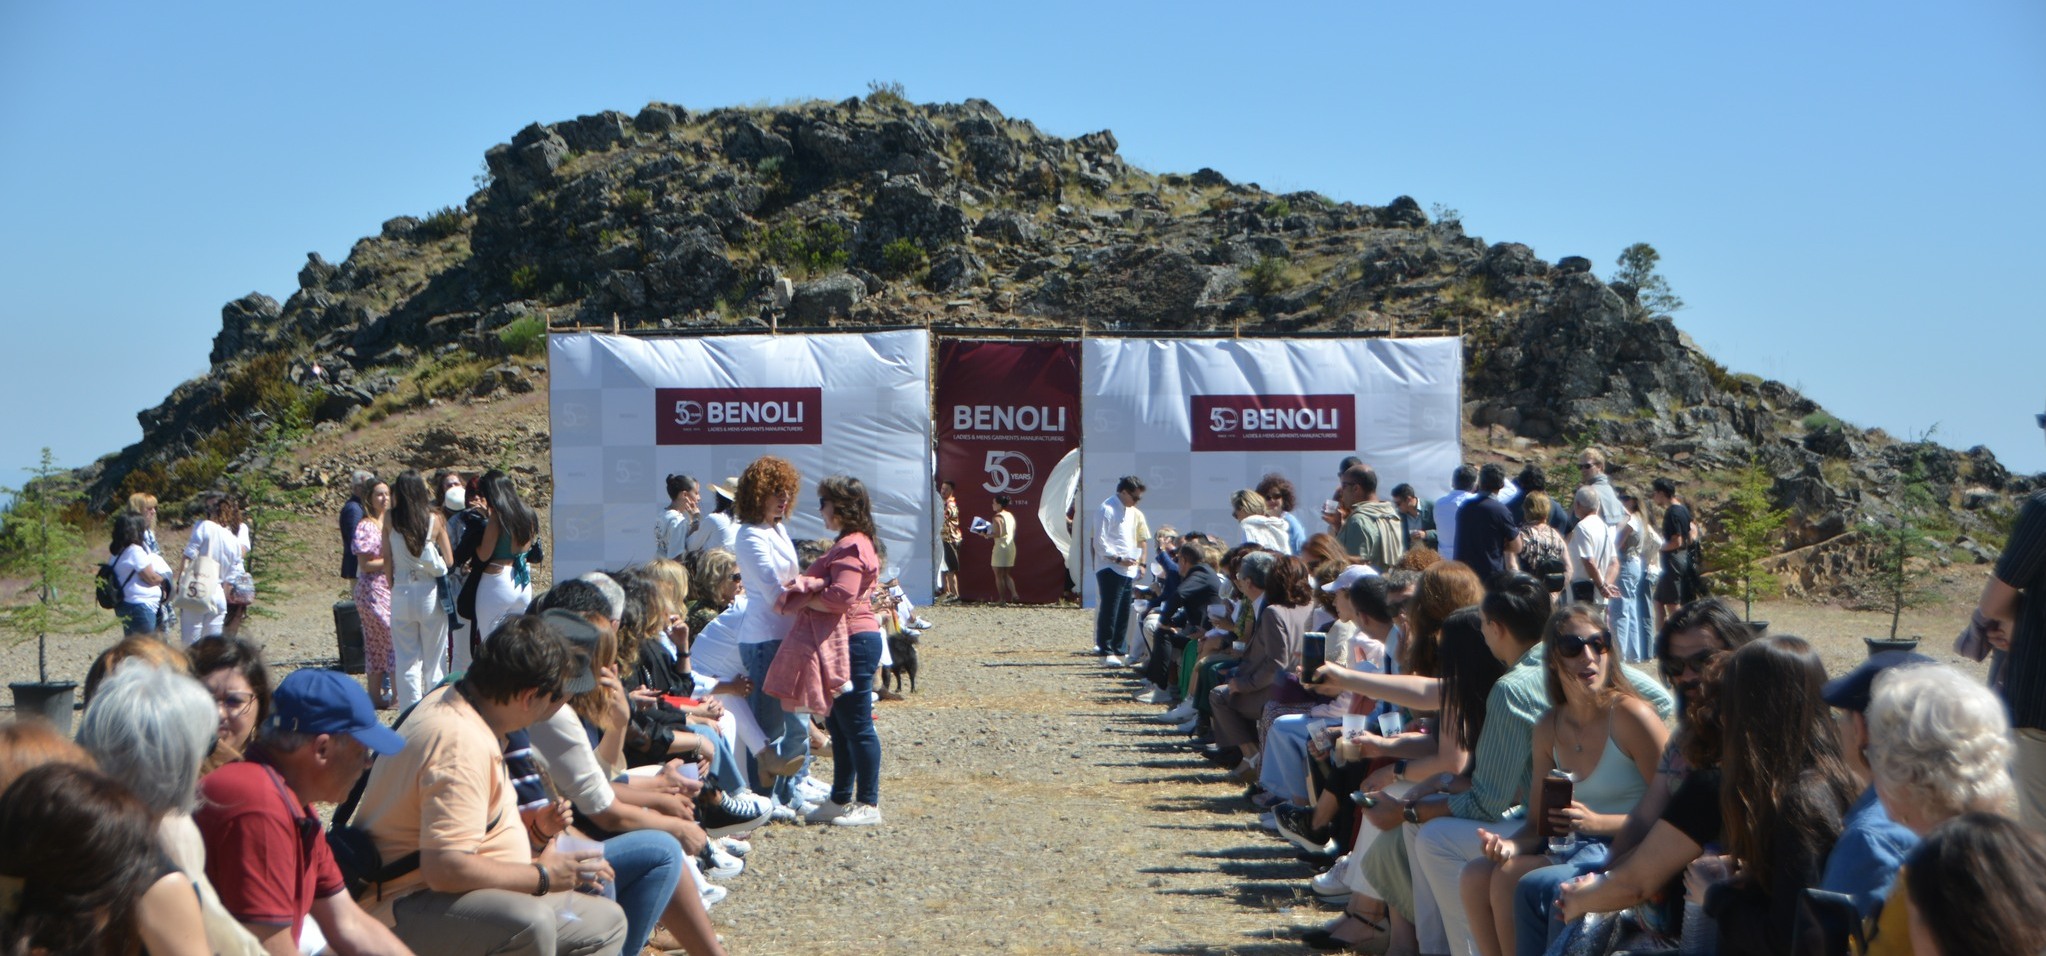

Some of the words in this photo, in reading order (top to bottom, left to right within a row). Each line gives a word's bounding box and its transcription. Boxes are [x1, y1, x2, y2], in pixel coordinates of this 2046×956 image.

[675, 400, 704, 425] 50
[707, 401, 803, 423] BENOLI
[953, 405, 1065, 431] BENOLI
[1210, 407, 1239, 432] 50
[1242, 407, 1338, 430] BENOLI
[982, 450, 1034, 494] 50
